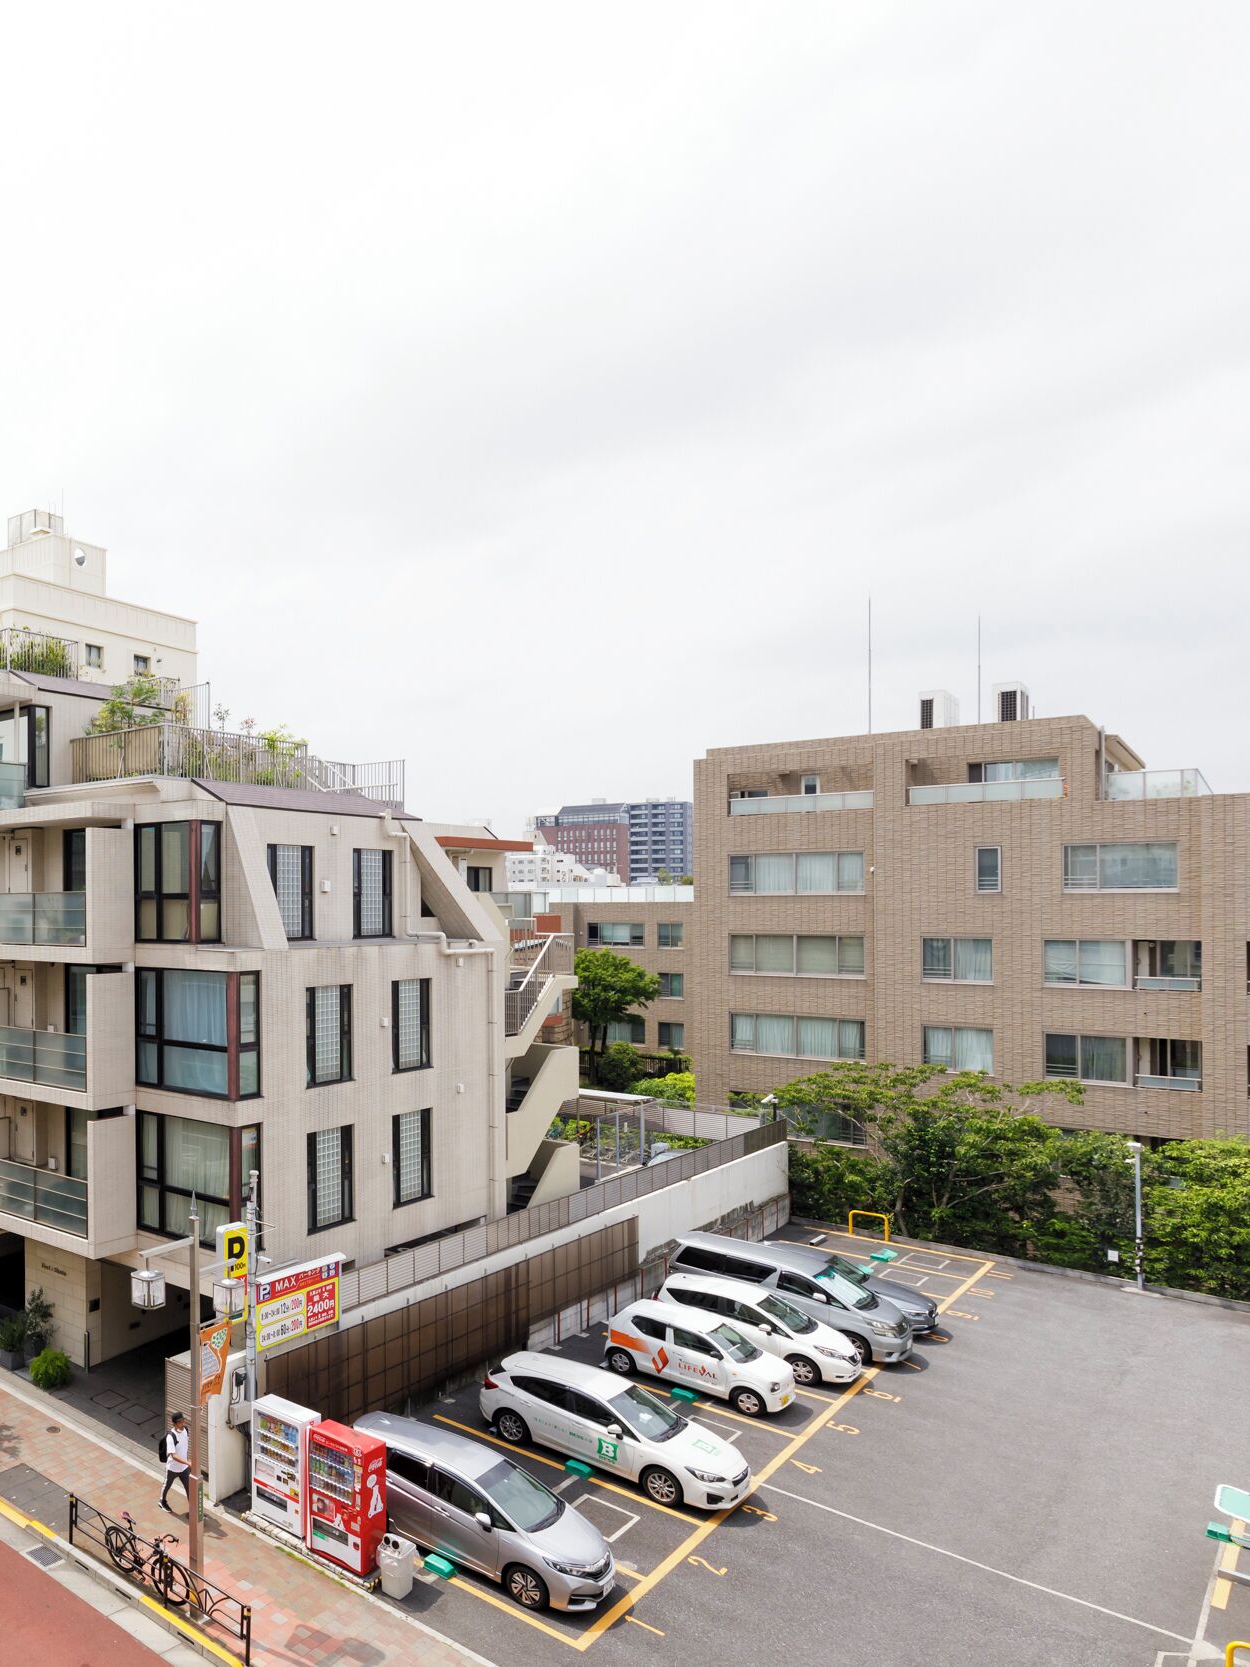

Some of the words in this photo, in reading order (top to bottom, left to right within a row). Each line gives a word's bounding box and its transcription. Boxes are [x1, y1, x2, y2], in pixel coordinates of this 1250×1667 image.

[275, 1276, 297, 1293] MAX
[307, 1300, 335, 1317] 2400円
[826, 1420, 861, 1435] 5
[789, 1459, 823, 1475] 4
[742, 1504, 778, 1522] 3
[687, 1555, 728, 1576] 2
[624, 1615, 666, 1636] 1
